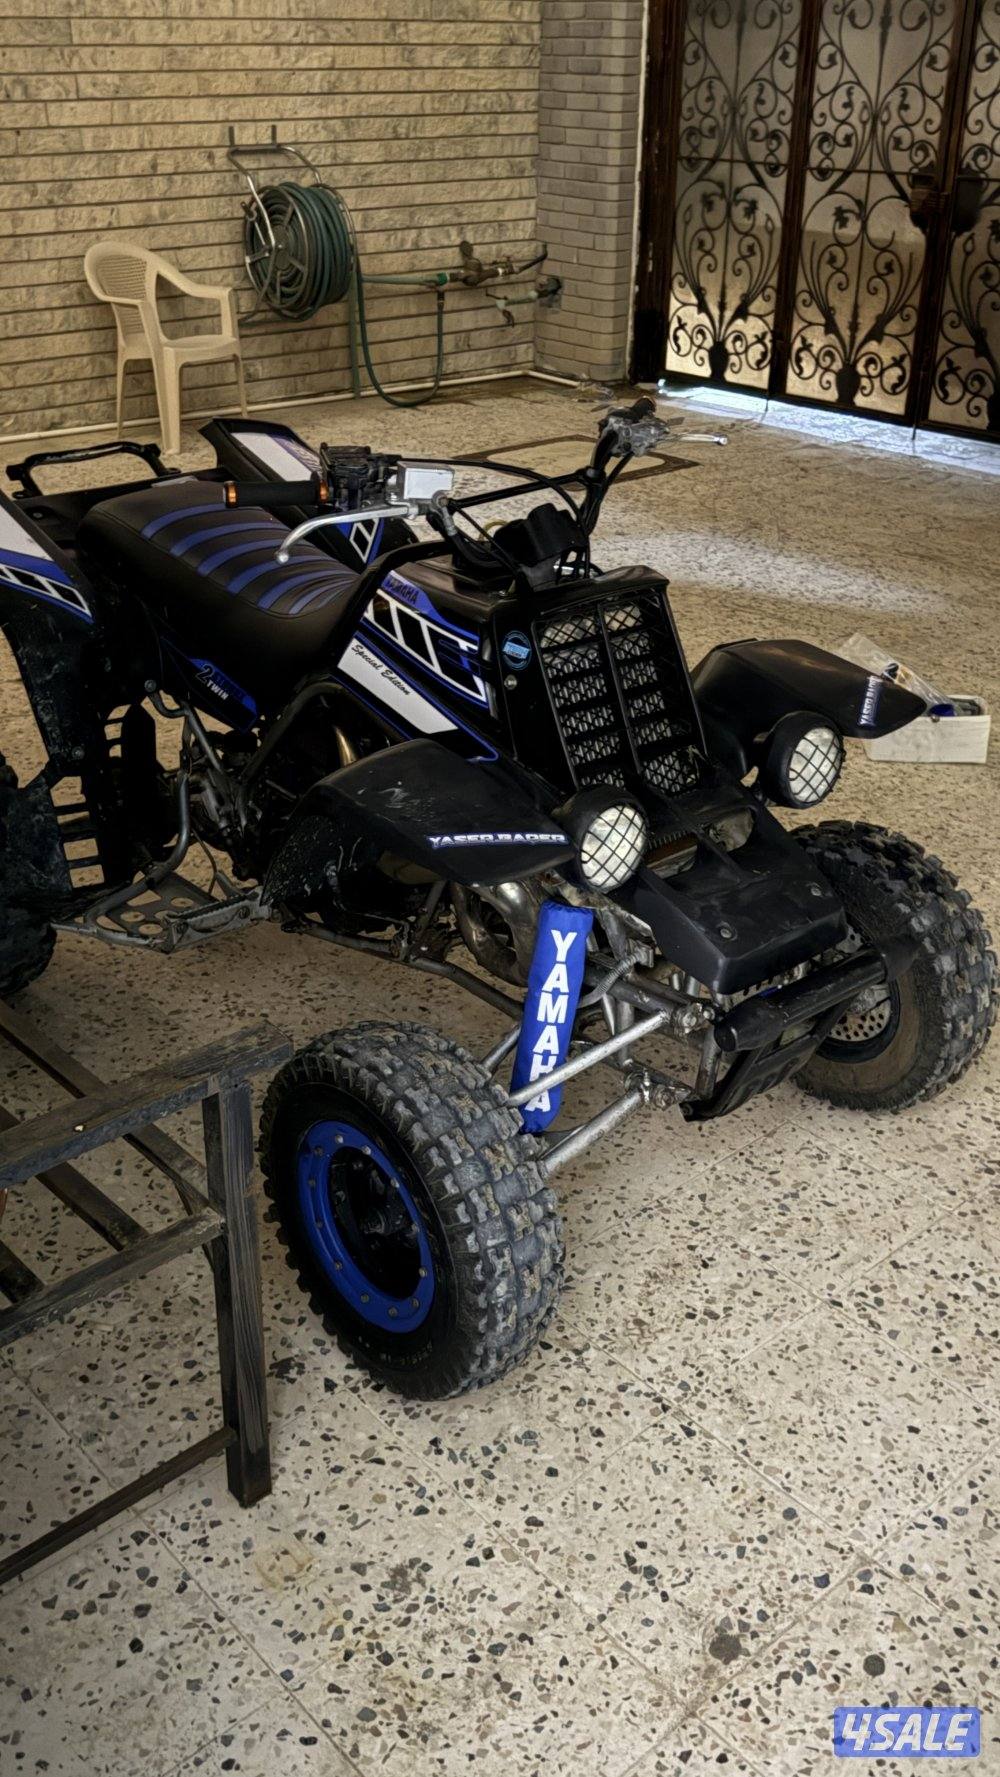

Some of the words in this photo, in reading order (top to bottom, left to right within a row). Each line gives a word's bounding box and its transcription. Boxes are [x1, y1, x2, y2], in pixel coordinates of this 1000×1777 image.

[351, 644, 383, 670] Special
[381, 669, 410, 695] Edition
[206, 679, 229, 700] TWIN
